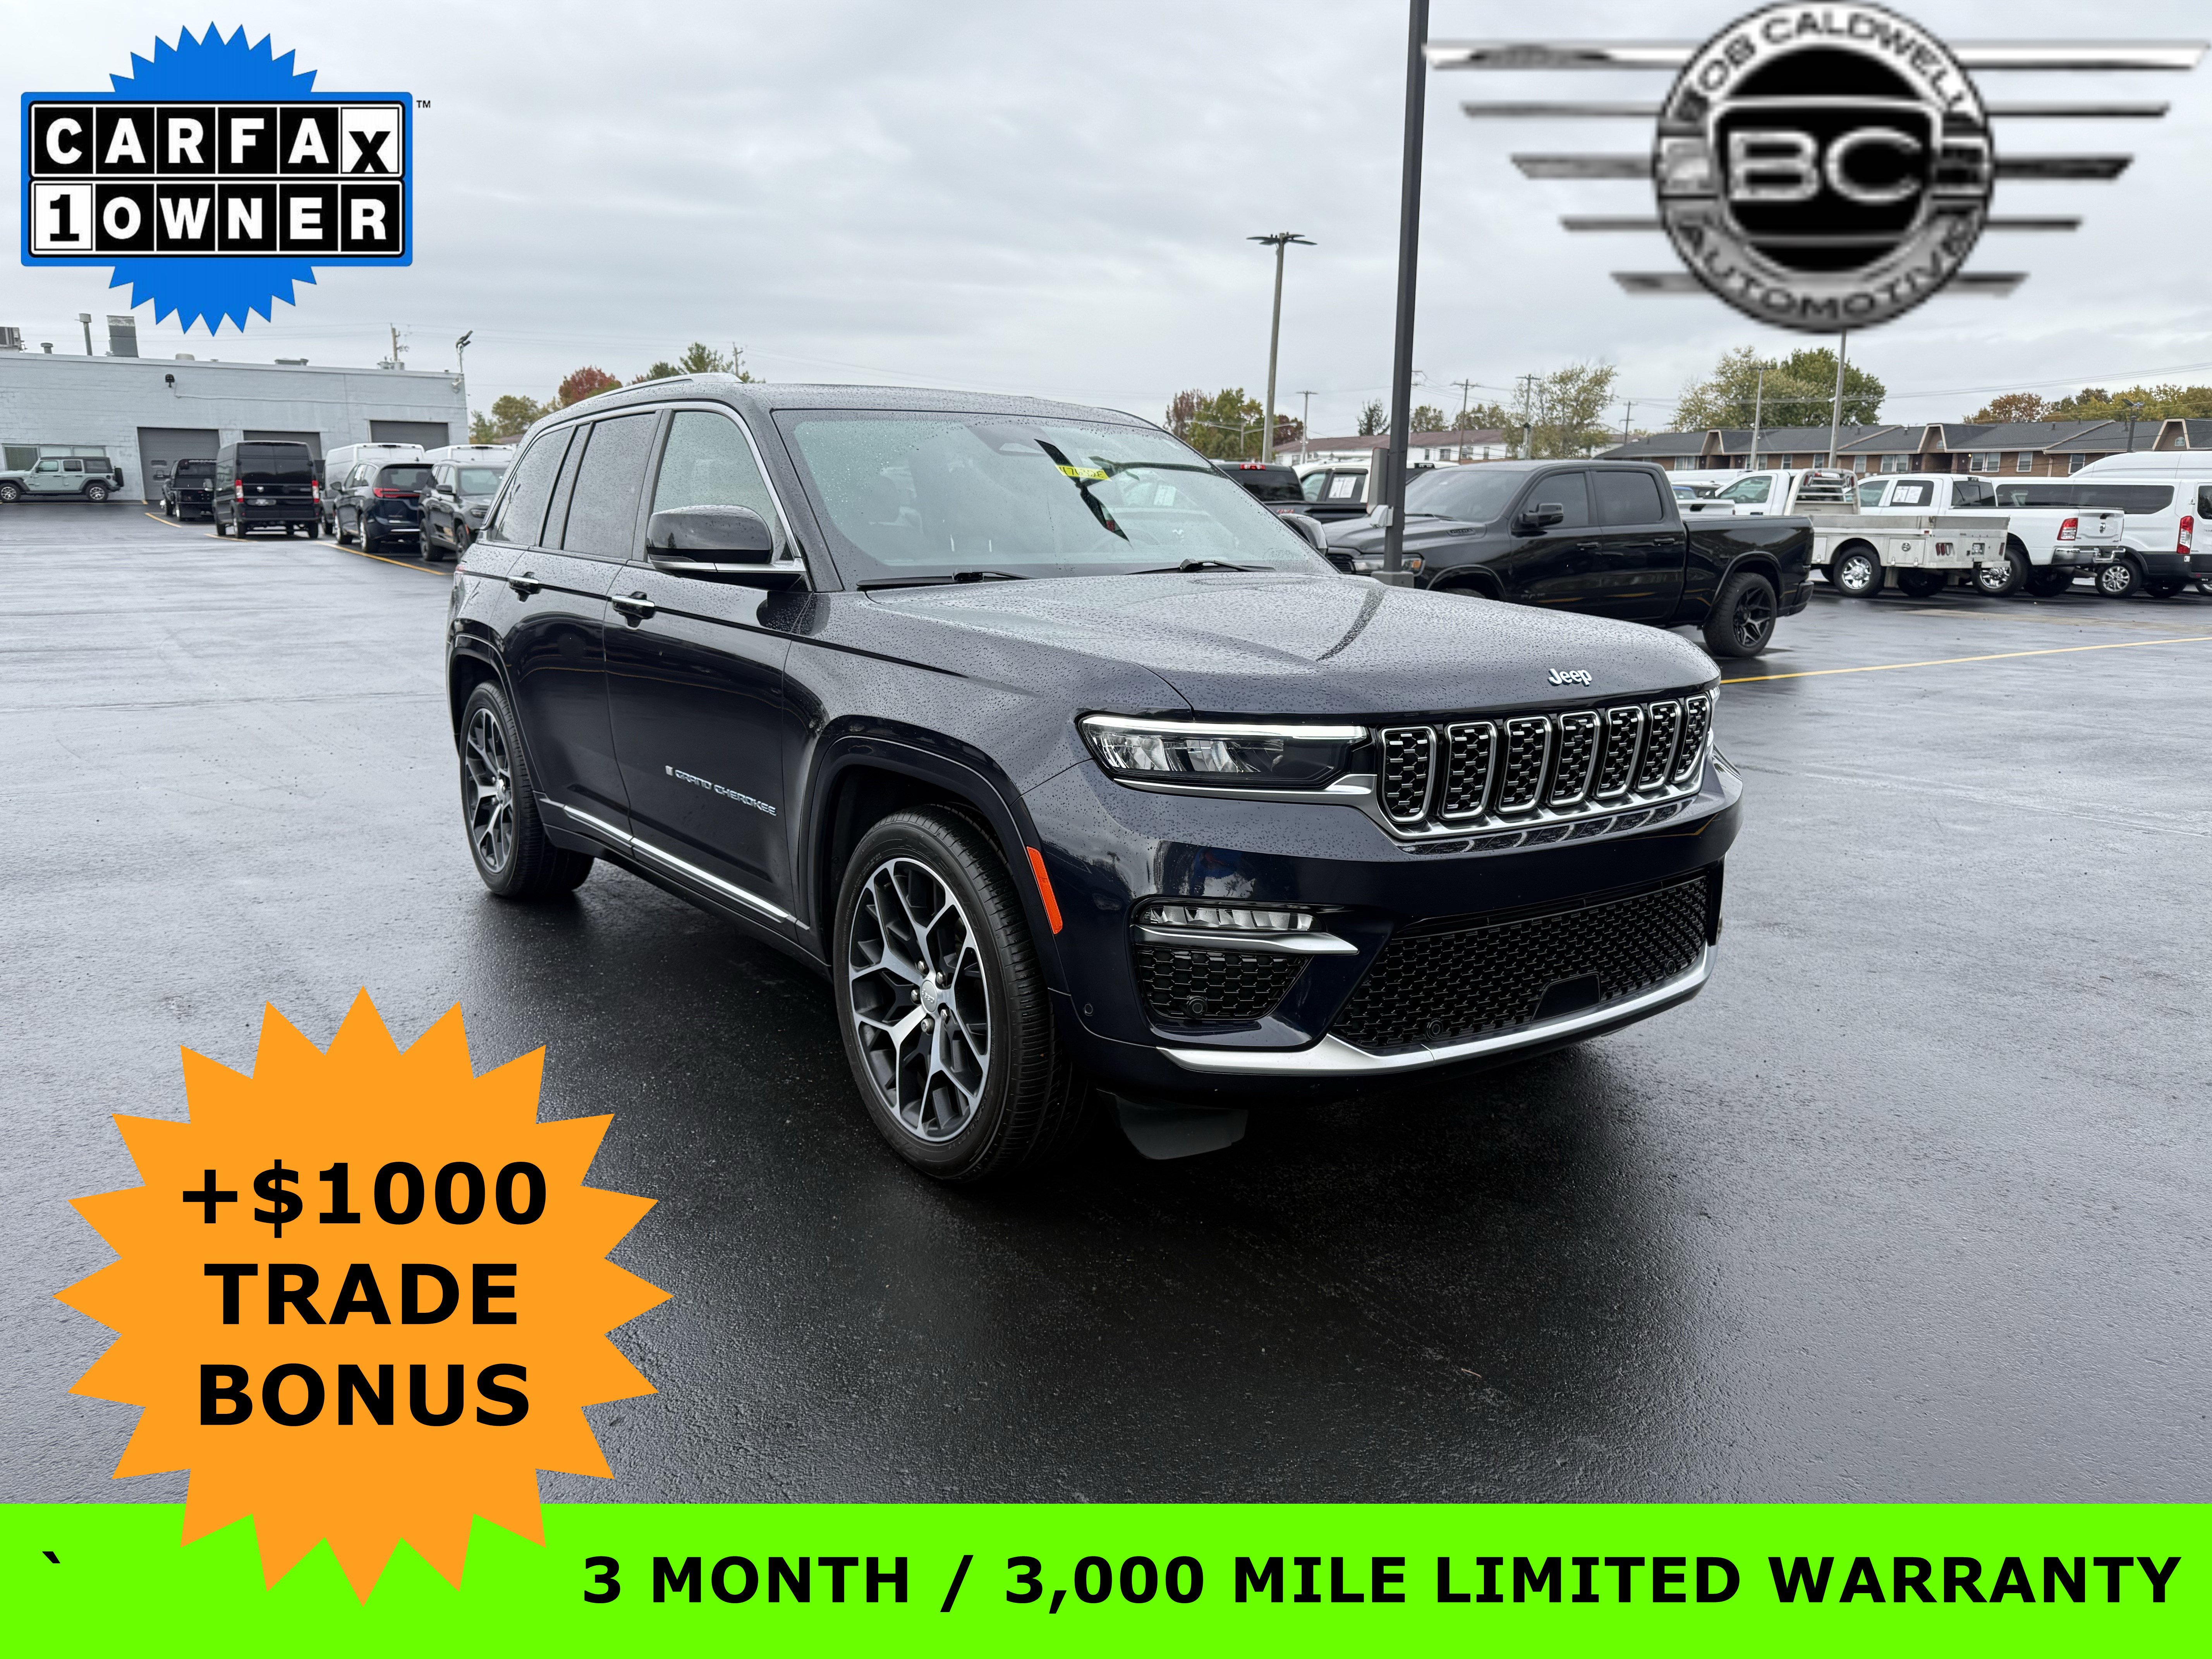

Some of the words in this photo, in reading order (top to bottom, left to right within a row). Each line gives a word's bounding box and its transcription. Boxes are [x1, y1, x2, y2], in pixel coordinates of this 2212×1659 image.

[1548, 668, 1592, 686] Jeep
[675, 769, 713, 790] GRAND
[713, 784, 778, 816] CHEROKEE
